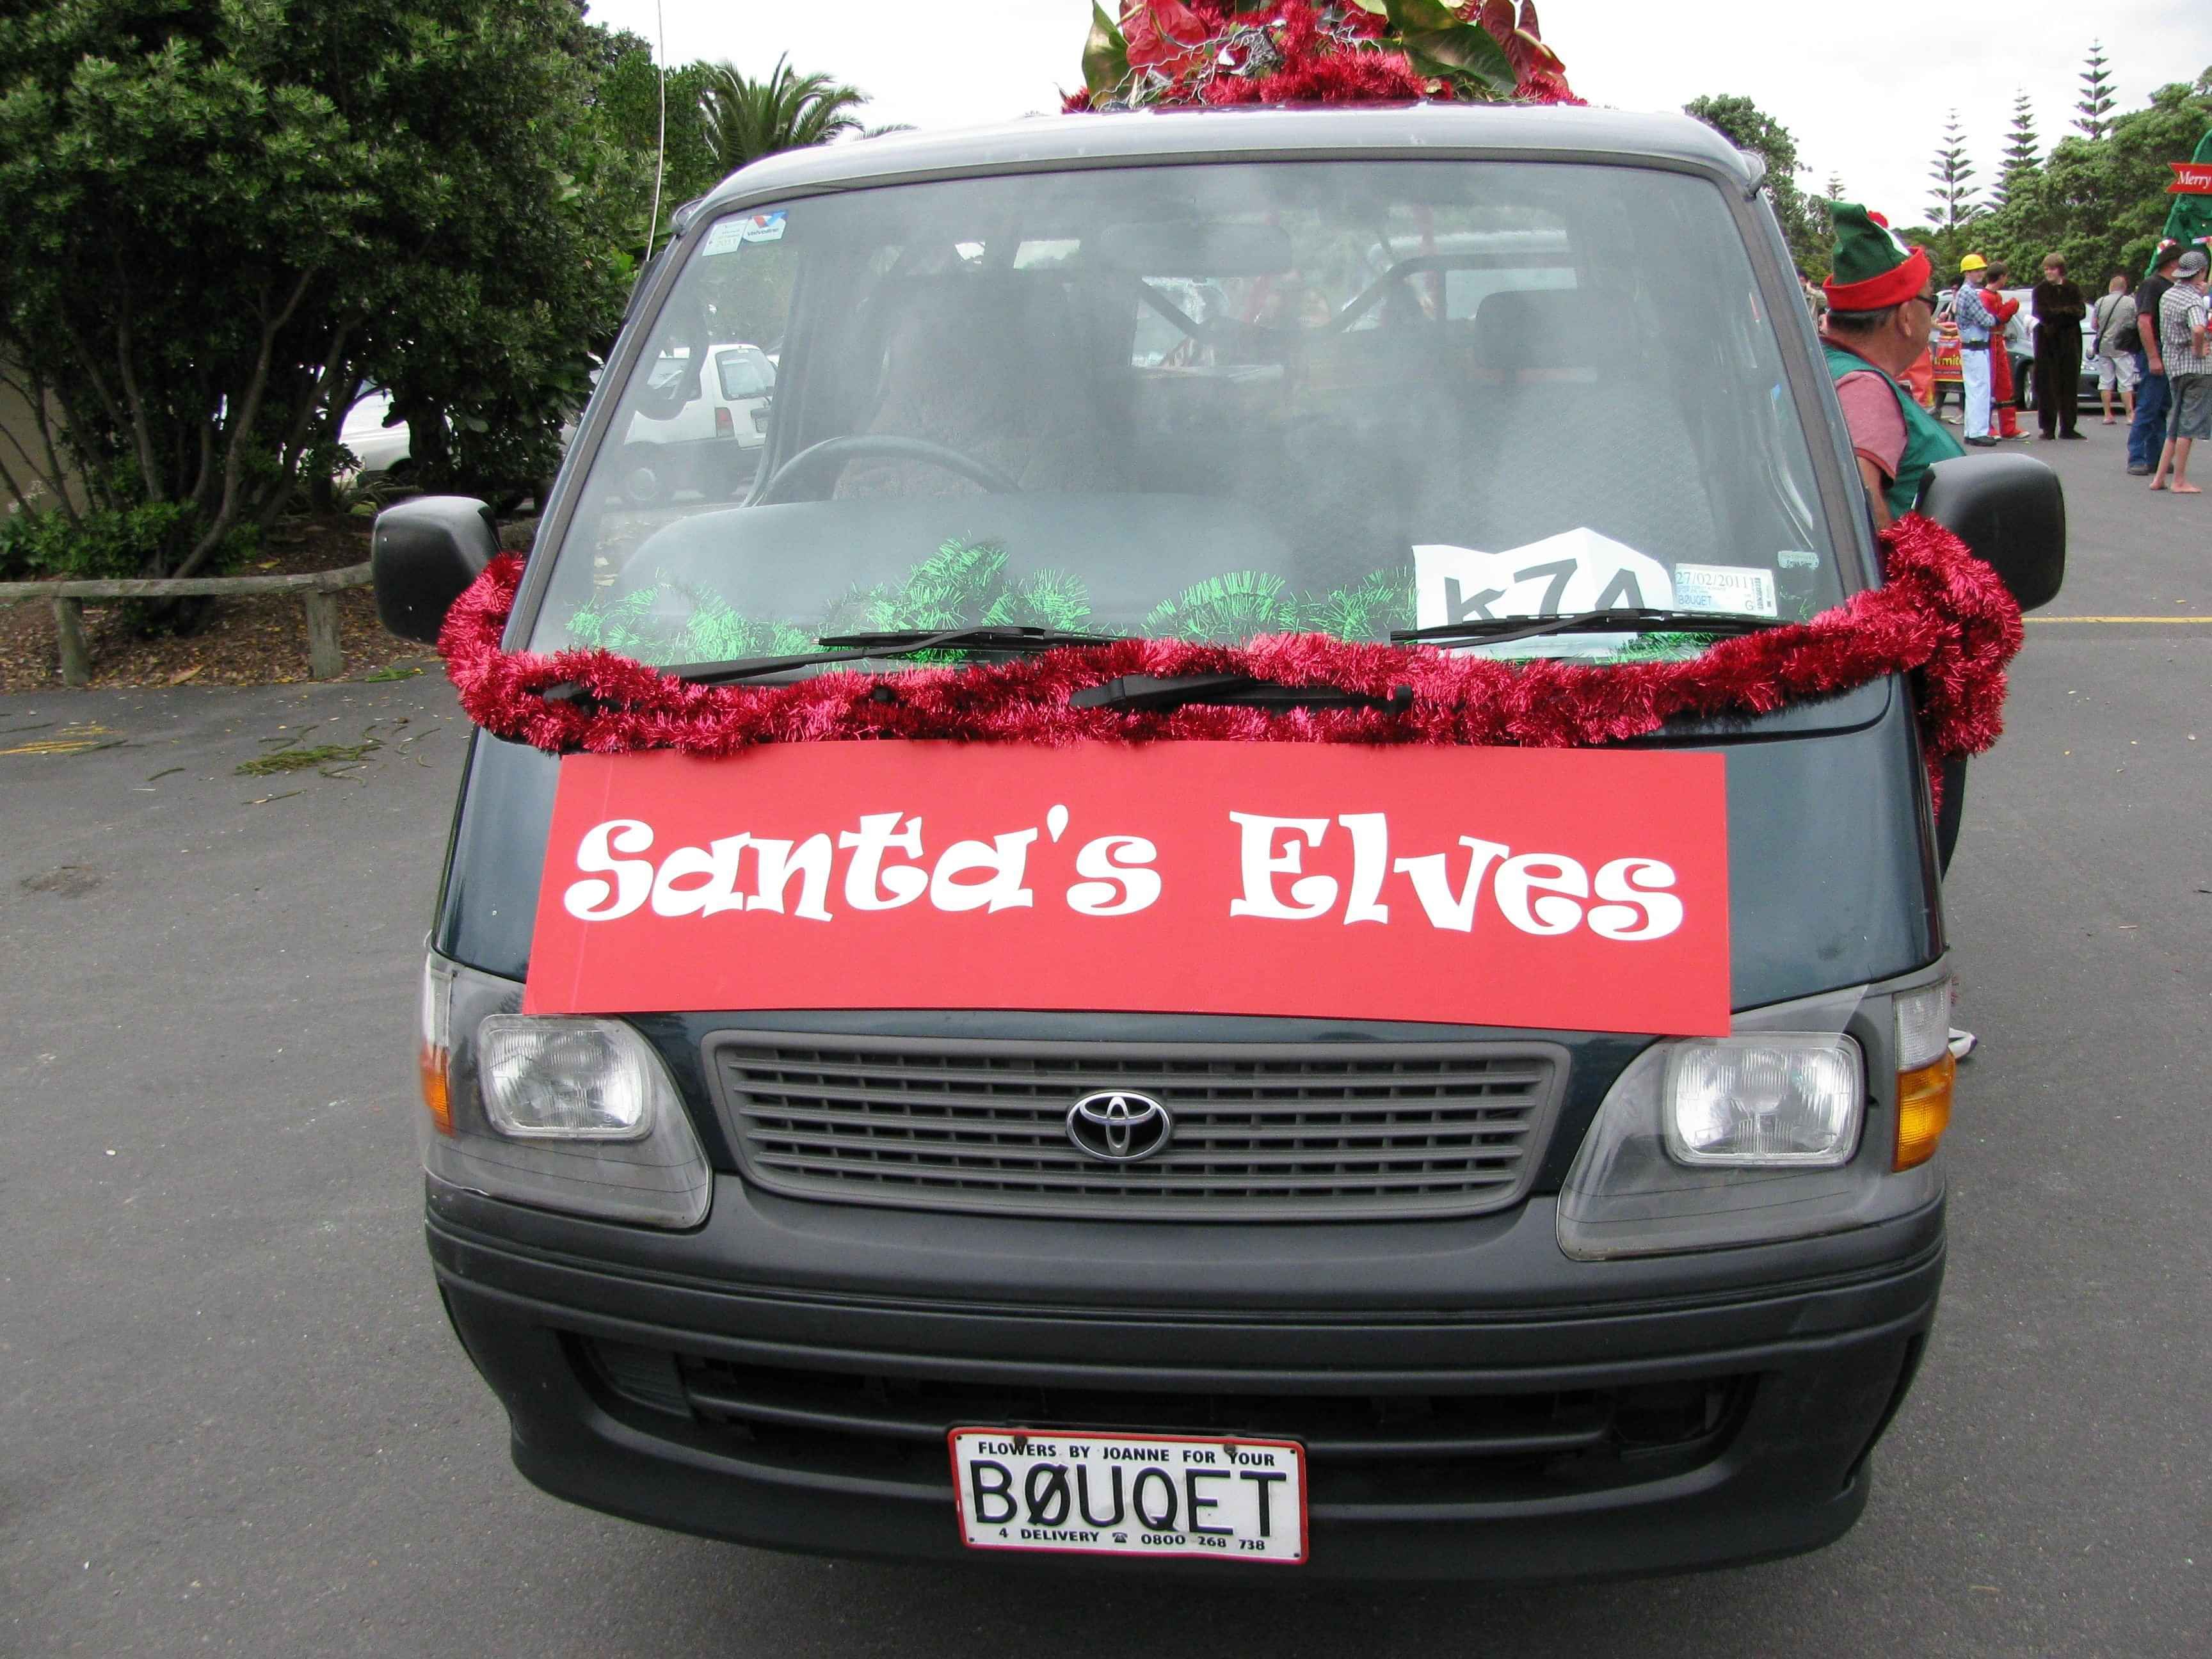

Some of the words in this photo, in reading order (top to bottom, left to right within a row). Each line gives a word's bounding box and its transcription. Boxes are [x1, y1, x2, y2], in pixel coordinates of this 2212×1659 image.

[2177, 170, 2211, 189] Merry
[1676, 572, 1749, 589] 27/02/2011
[564, 804, 1162, 922] Santa's
[1229, 810, 1684, 942] Elves
[978, 1441, 1057, 1457] FLOWERS
[1070, 1445, 1091, 1459] BY
[1103, 1447, 1170, 1462] JOANNE
[1183, 1450, 1216, 1464] FOR
[1228, 1452, 1275, 1466] YOUR
[999, 1528, 1009, 1539] 4
[1020, 1528, 1100, 1543] DELIVERY
[1141, 1534, 1186, 1546] 0800
[1198, 1536, 1227, 1548] 268
[1238, 1539, 1266, 1551] 738
